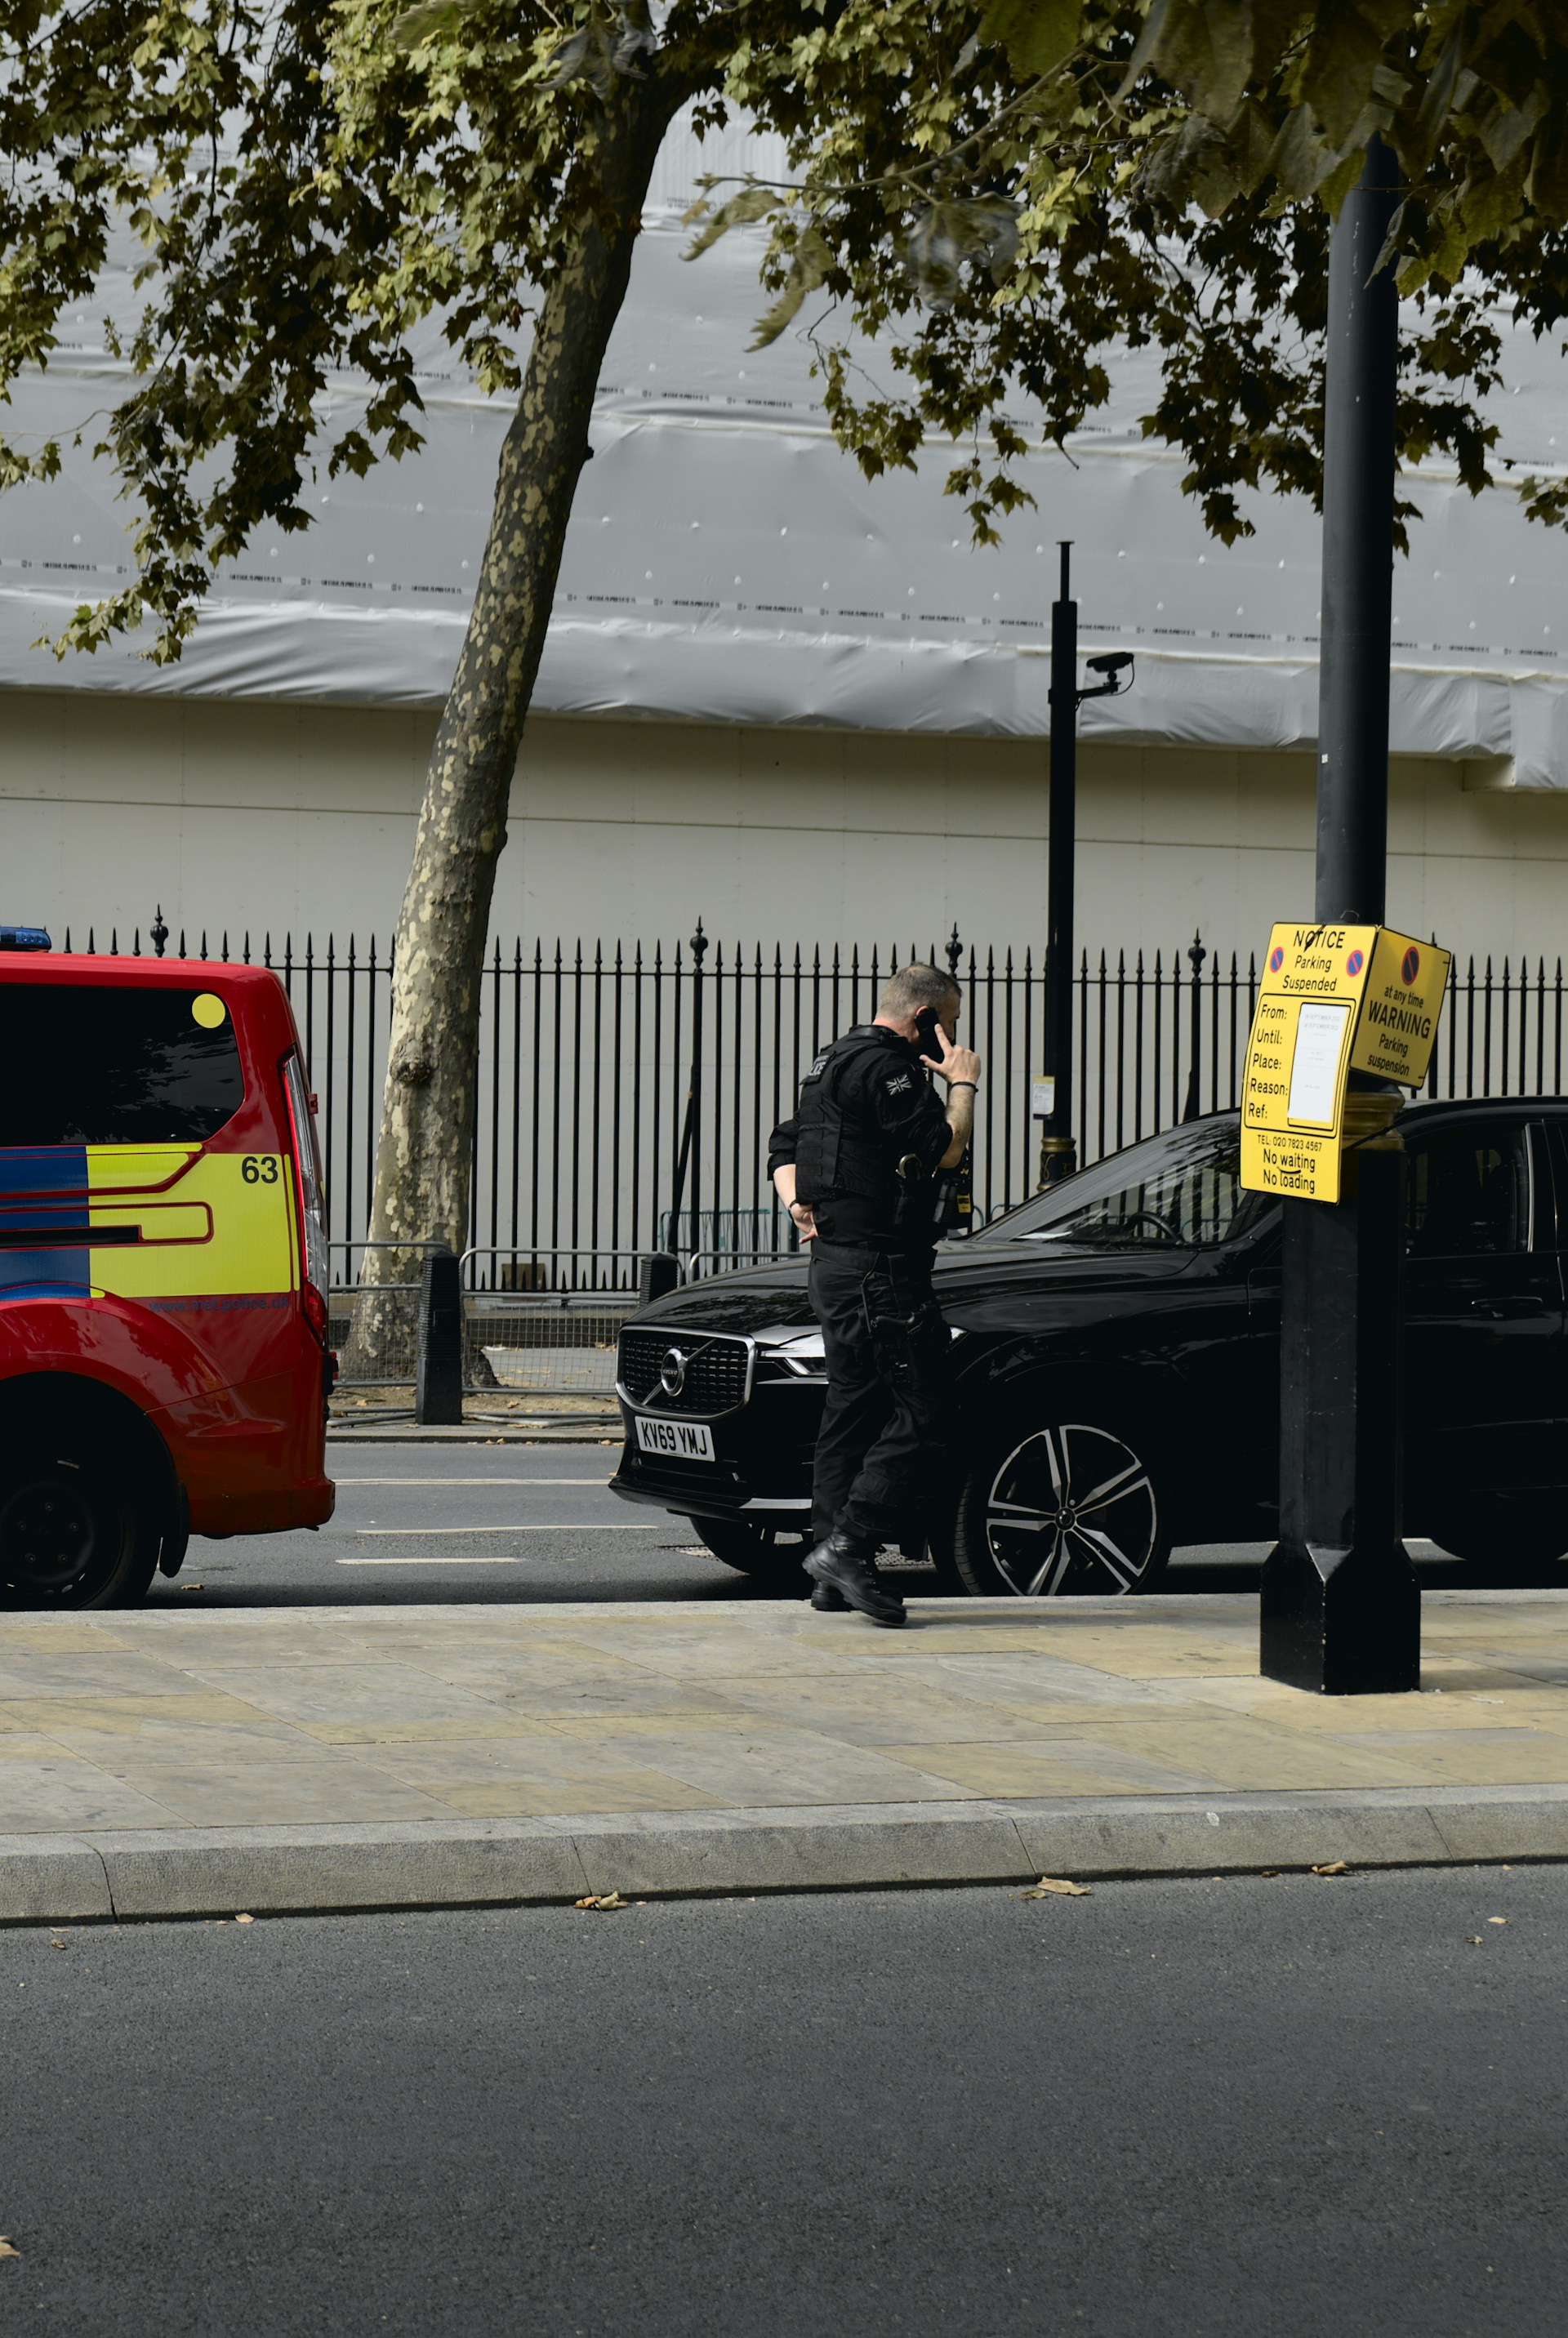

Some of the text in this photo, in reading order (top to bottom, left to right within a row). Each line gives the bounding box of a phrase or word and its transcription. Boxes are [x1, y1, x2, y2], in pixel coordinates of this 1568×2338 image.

[1293, 930, 1346, 949] NOTICE
[1294, 955, 1332, 973] Parking
[1282, 975, 1338, 992] Suspended
[1384, 985, 1424, 1009] at any time
[1260, 1004, 1287, 1019] From:
[1368, 1000, 1431, 1040] WARNING
[1257, 1028, 1283, 1044] Until:
[1379, 1033, 1409, 1058] Parking
[1252, 1053, 1281, 1070] Place:
[1367, 1053, 1410, 1077] suspension
[1250, 1078, 1289, 1096] Reason:
[1248, 1102, 1268, 1119] Ref:
[1258, 1134, 1322, 1152] TEL: 020 7823 4567
[1263, 1148, 1316, 1173] No waiting
[242, 1156, 278, 1184] 63
[1263, 1169, 1315, 1194] No loading
[149, 1295, 288, 1313] www.met.police.uk
[641, 1421, 707, 1455] KV69 YMJ
